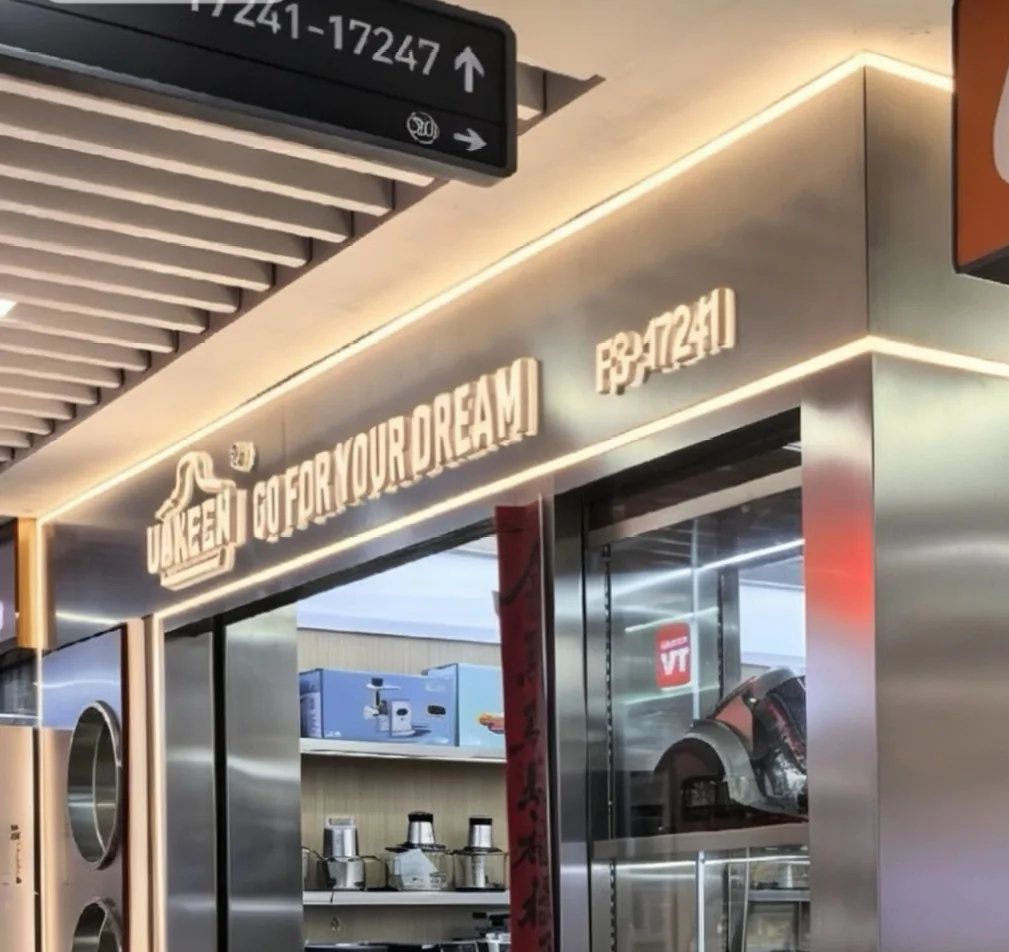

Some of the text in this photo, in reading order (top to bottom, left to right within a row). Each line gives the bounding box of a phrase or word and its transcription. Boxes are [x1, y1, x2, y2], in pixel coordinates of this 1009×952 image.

[191, 0, 440, 75] 241-17247
[252, 357, 538, 543] GO FOR YOUR DREAM
